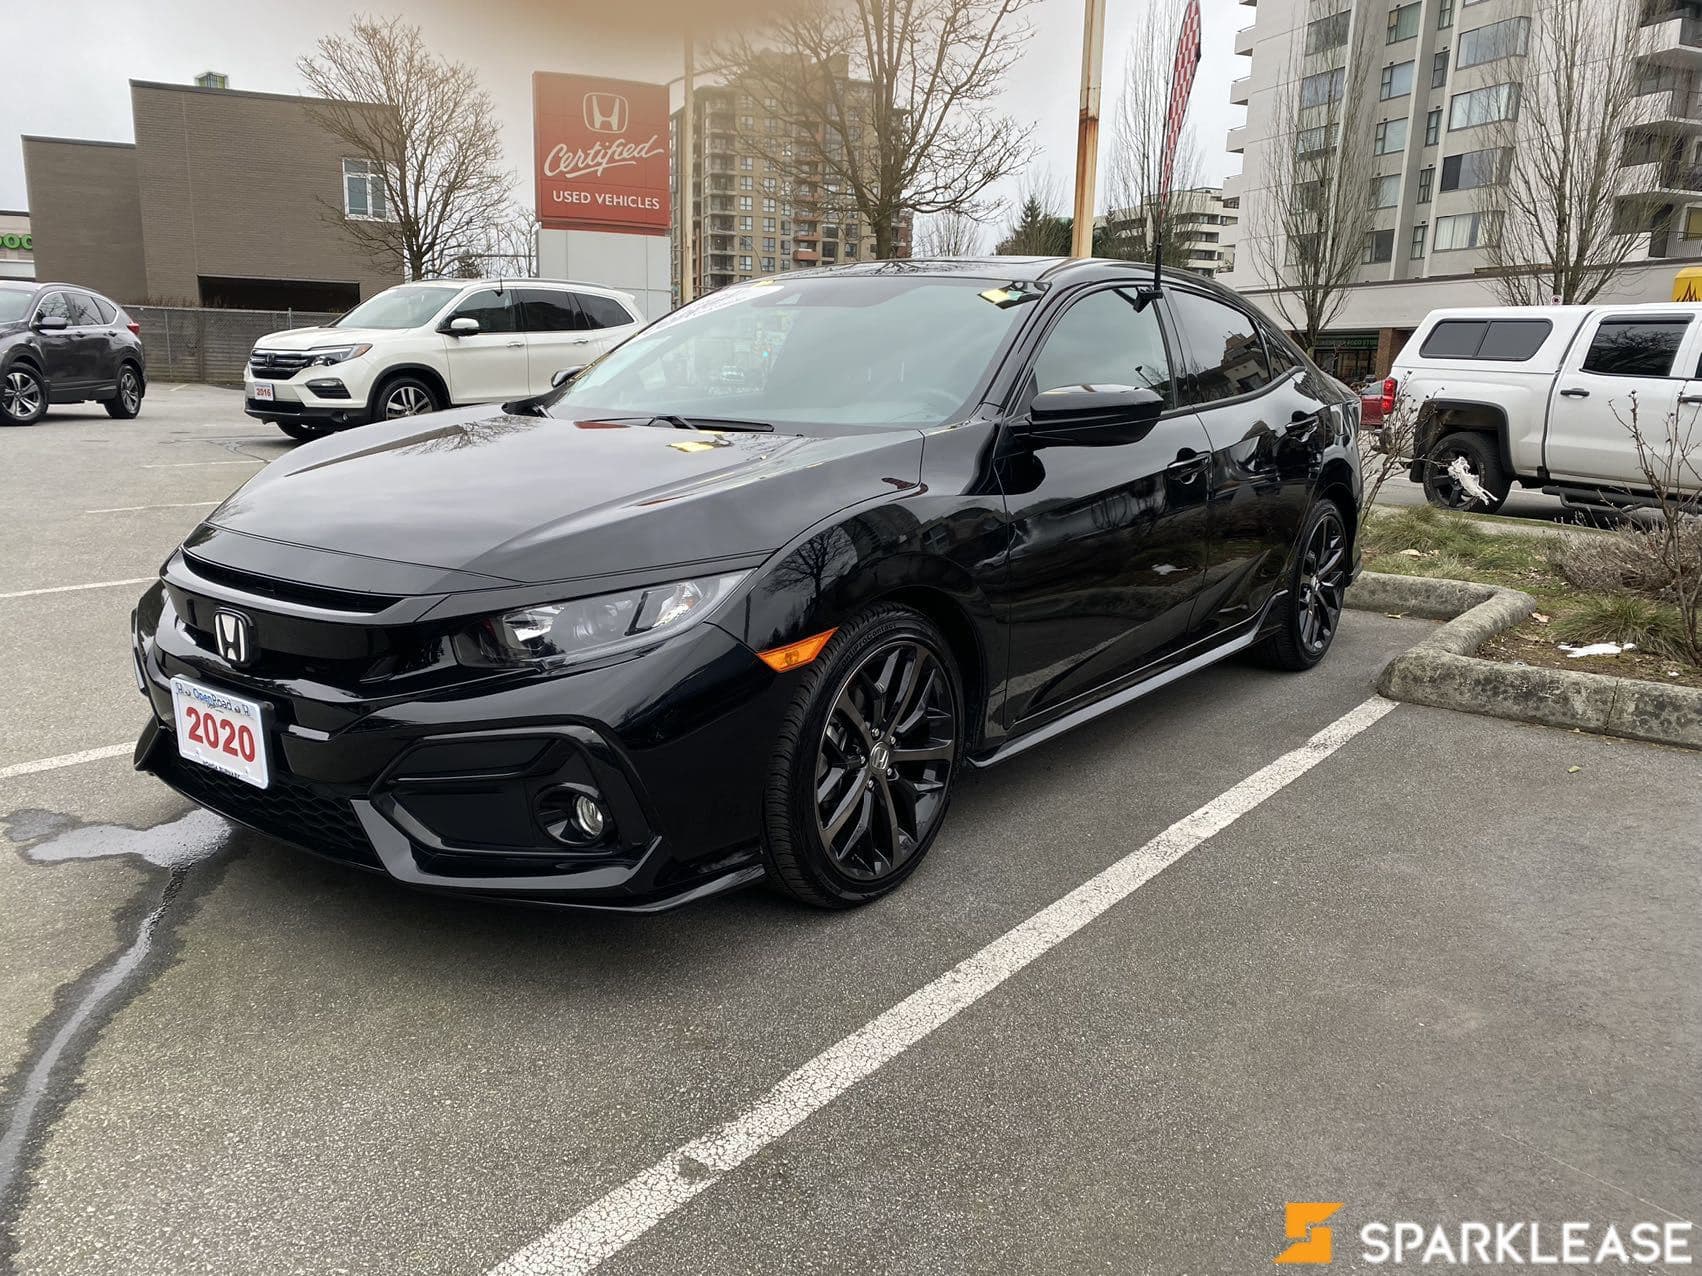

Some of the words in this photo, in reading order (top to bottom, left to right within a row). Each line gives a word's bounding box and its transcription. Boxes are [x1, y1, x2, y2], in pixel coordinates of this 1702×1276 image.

[543, 134, 664, 178] Certified
[553, 190, 591, 204] USED
[595, 193, 660, 210] VEHICLES
[186, 706, 255, 763] 2020
